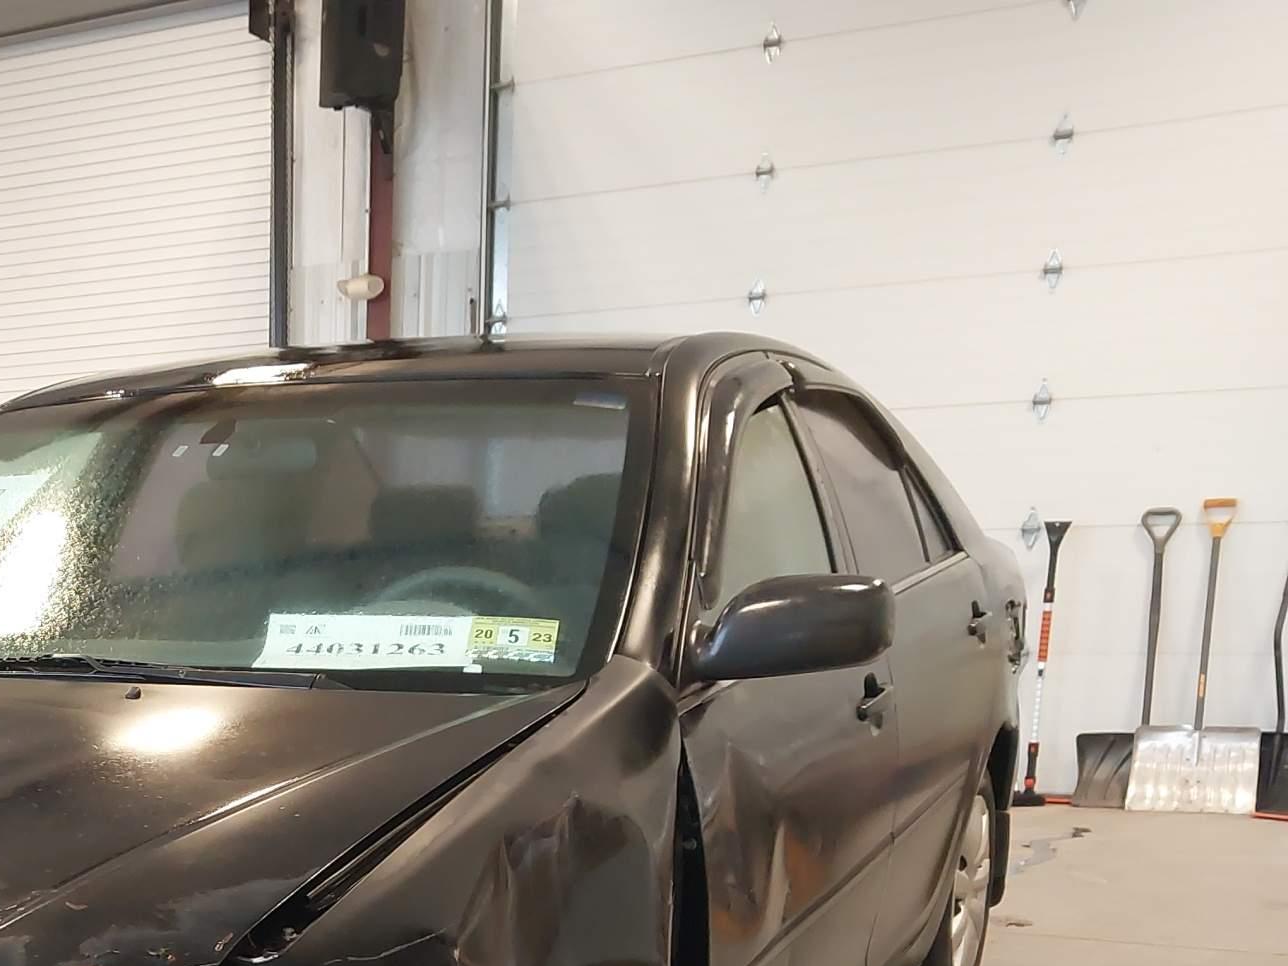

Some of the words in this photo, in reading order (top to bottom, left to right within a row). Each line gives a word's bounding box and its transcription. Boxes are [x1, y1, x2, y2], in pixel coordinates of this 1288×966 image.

[474, 629, 493, 639] 20
[508, 629, 520, 643] 5
[532, 632, 552, 642] 23
[285, 642, 446, 655] 44031263
